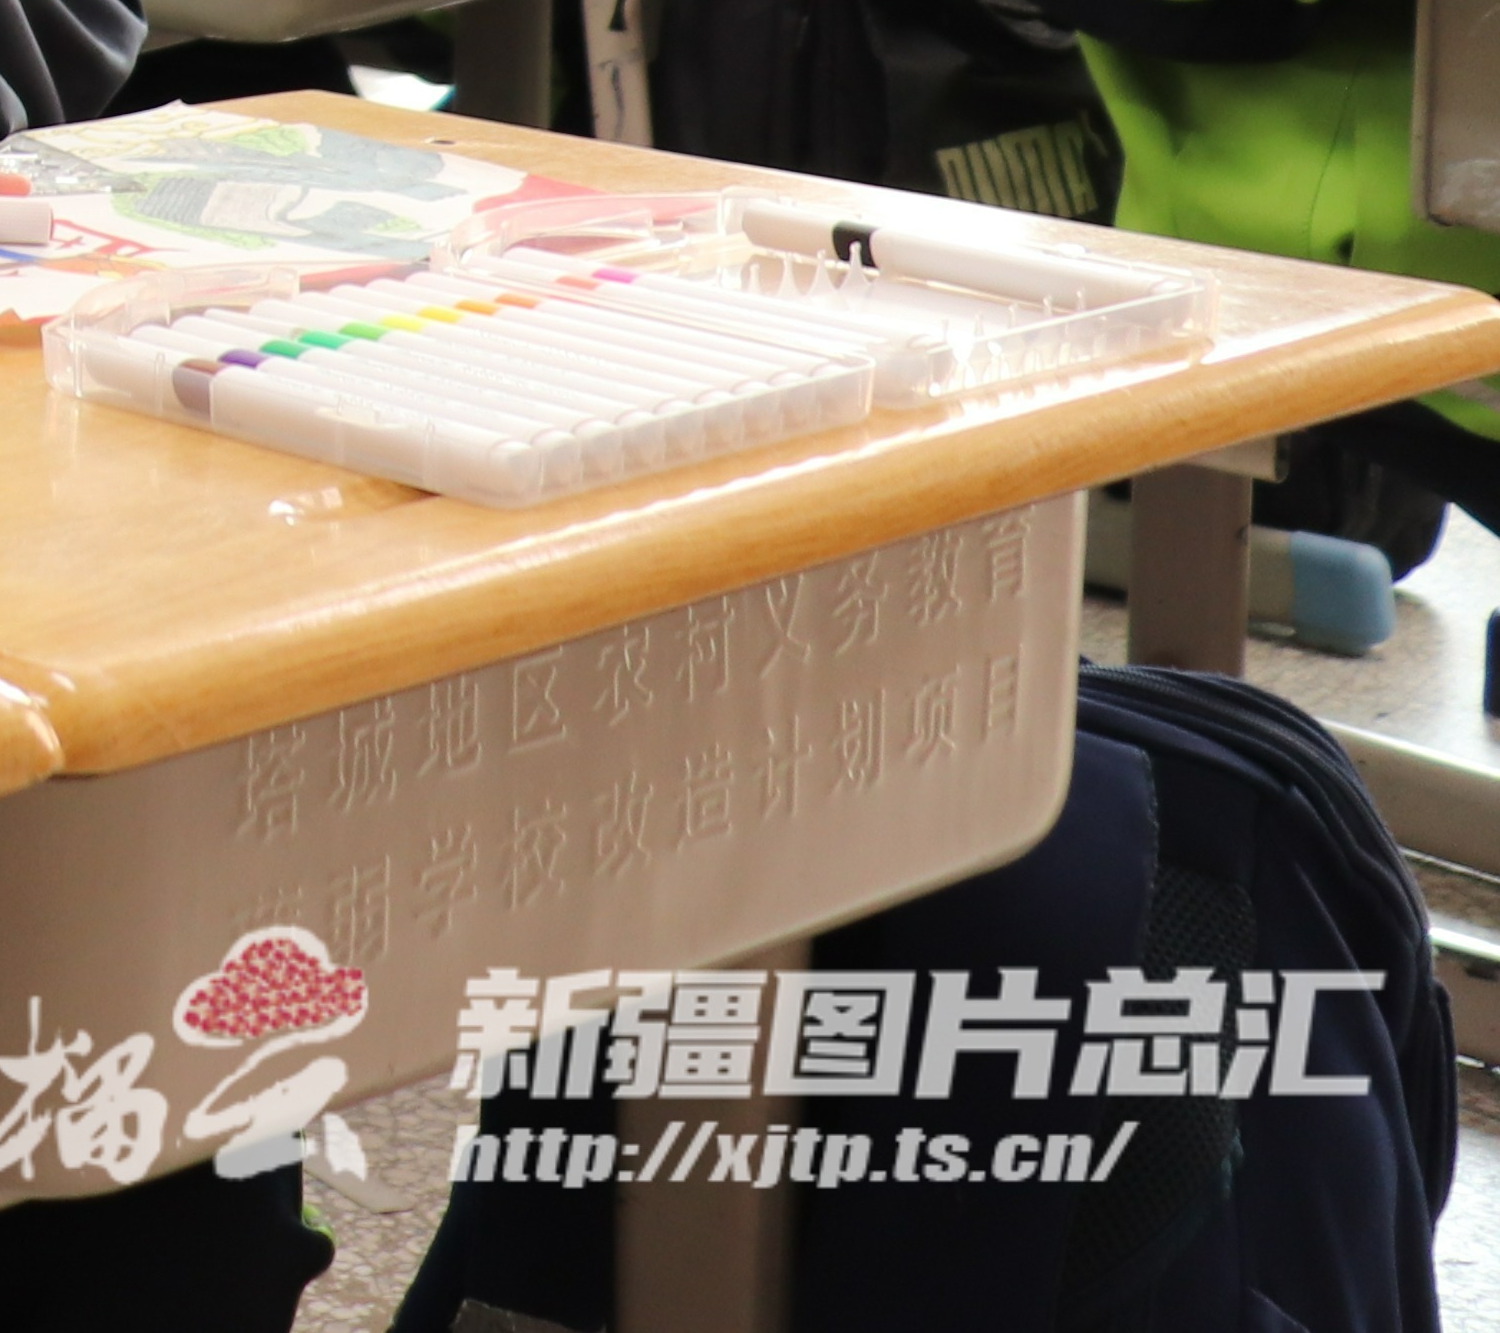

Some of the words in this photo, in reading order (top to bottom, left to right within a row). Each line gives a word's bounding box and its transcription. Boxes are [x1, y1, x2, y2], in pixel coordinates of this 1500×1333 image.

[234, 503, 1038, 845] 塔城地区农村义务教育
